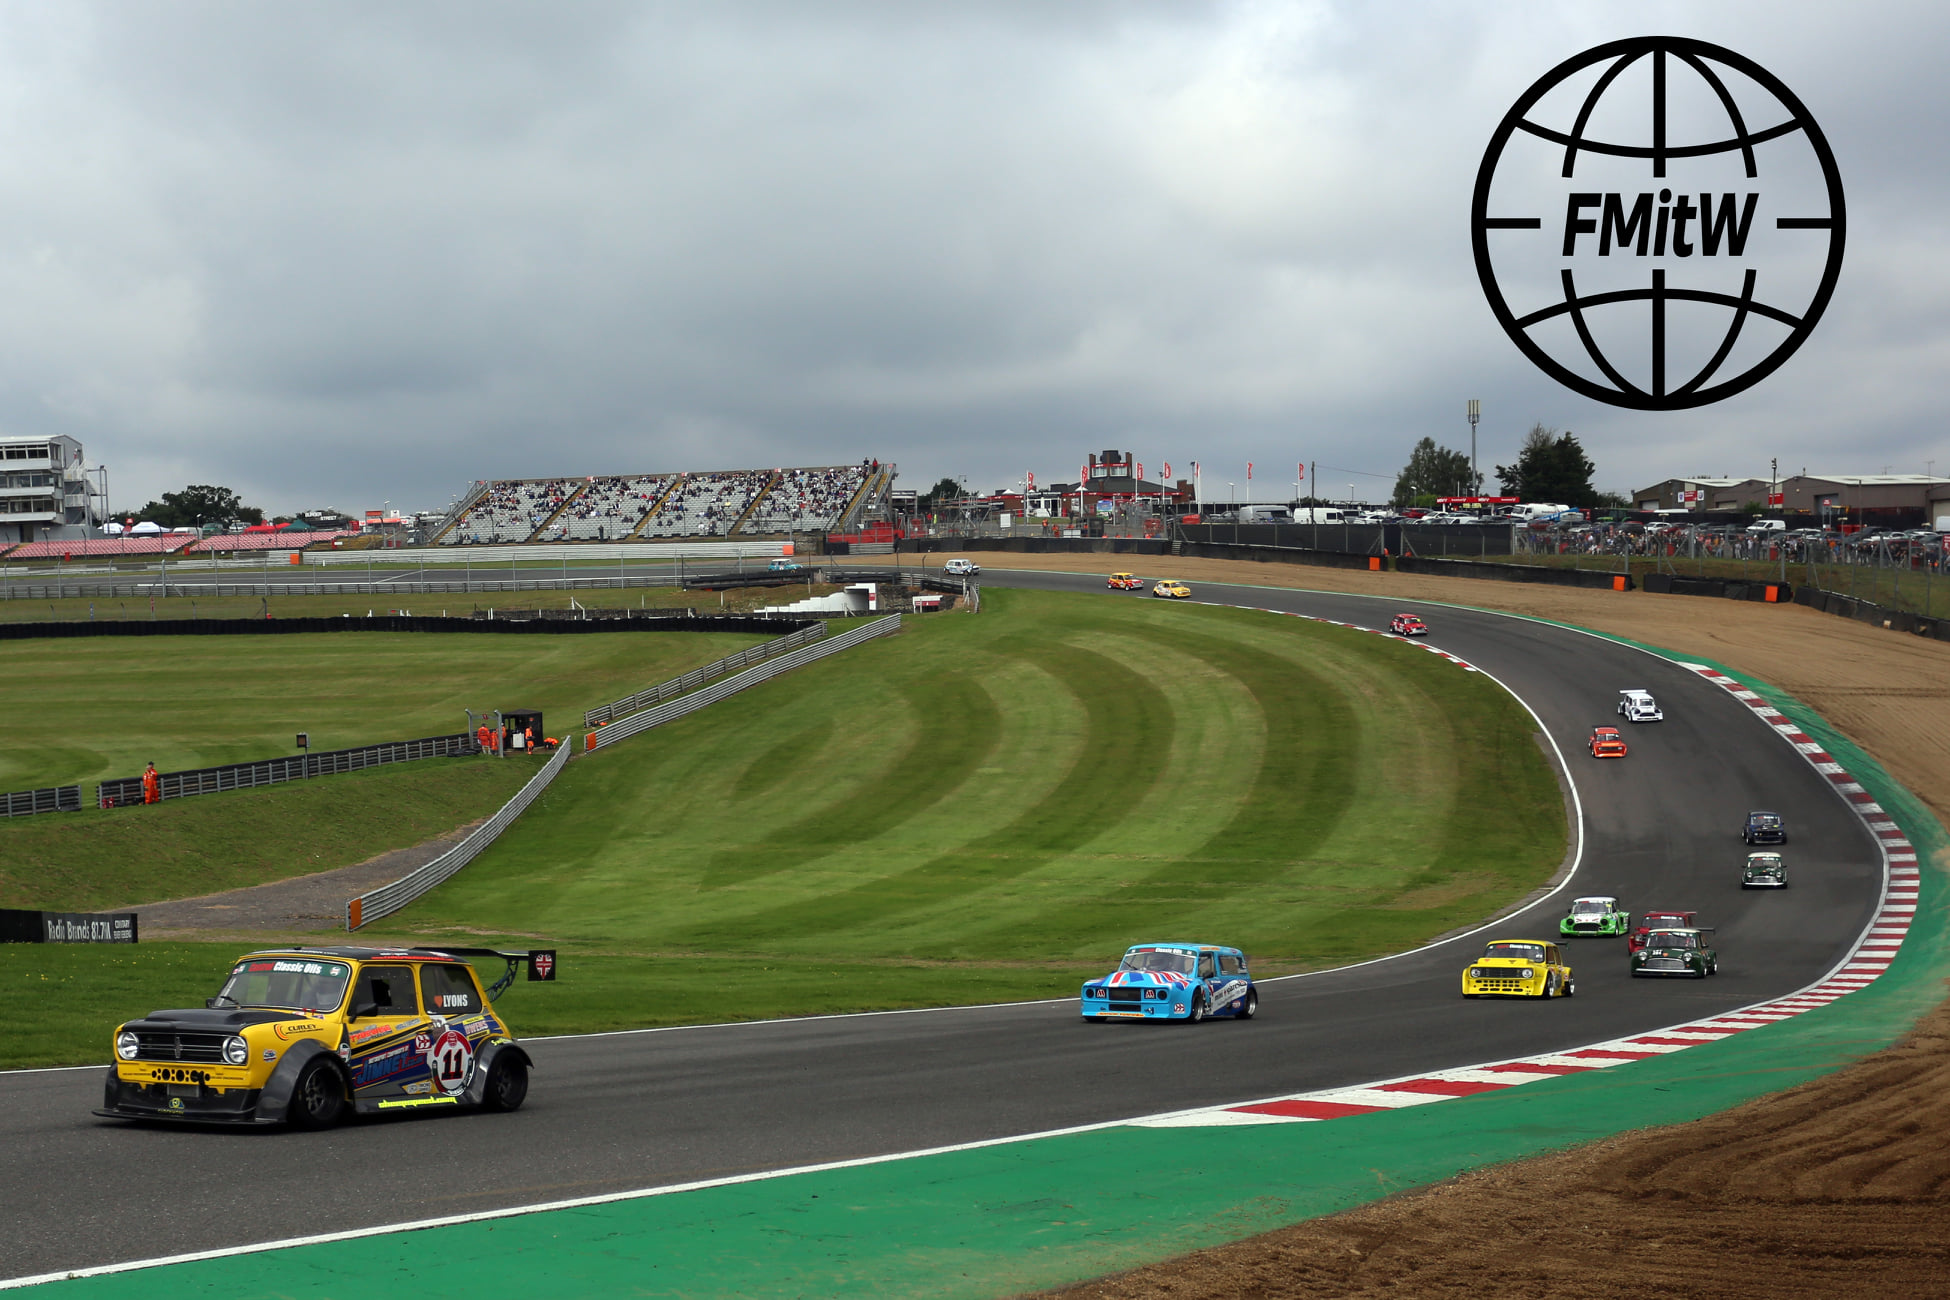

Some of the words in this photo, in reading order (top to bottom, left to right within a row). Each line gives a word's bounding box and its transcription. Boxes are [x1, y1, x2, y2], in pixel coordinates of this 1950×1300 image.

[273, 961, 303, 973] Classic
[303, 962, 323, 975] Oils
[443, 994, 469, 1008] LYONS
[441, 1048, 464, 1081] 11
